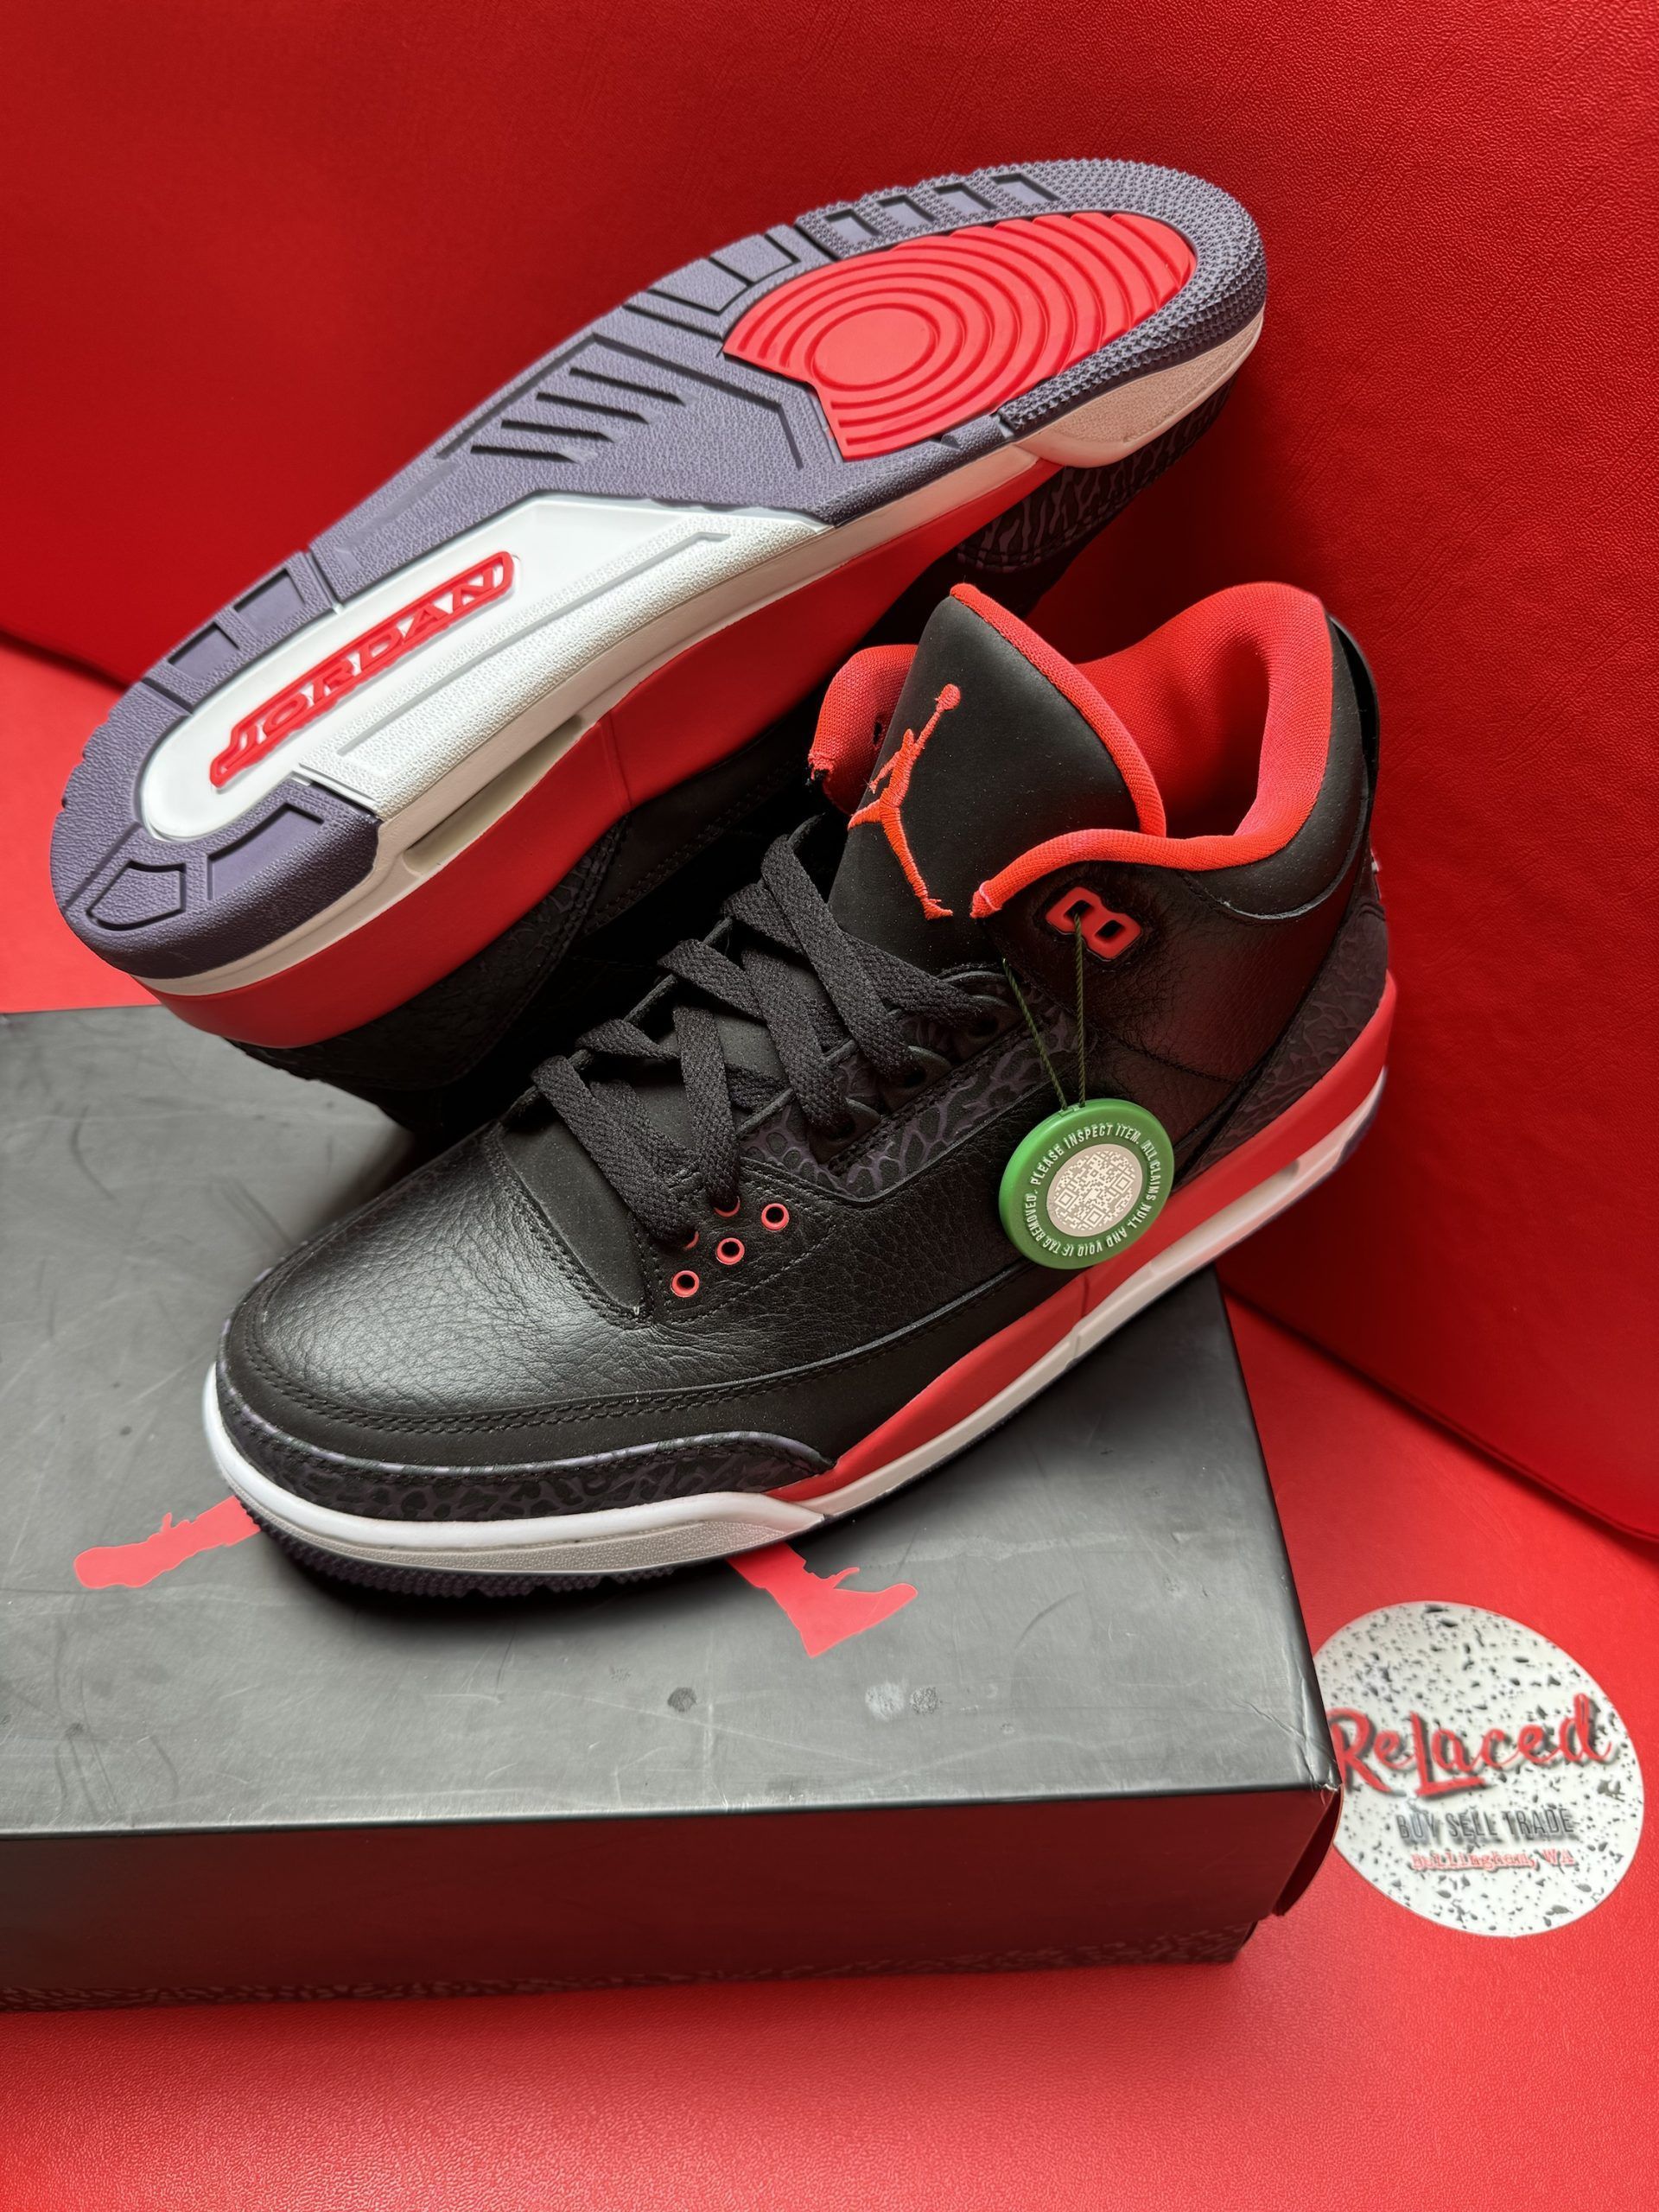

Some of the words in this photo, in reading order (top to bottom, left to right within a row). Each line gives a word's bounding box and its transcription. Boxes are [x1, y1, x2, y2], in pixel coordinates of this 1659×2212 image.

[212, 553, 512, 785] JORDAN
[1063, 1122, 1114, 1149] INSPECT
[1115, 1122, 1141, 1145] ITEM.
[1030, 1143, 1065, 1185] PLEASE
[1141, 1140, 1158, 1161] ALL
[1146, 1159, 1161, 1201] CLAIMS
[1024, 1190, 1048, 1242] REMOVED.
[1127, 1202, 1153, 1230] NULL
[1042, 1238, 1062, 1255] TAG
[1062, 1243, 1074, 1256] IF
[1077, 1243, 1103, 1257] VOID
[1106, 1226, 1128, 1248] AND
[1325, 1693, 1612, 1798] ReLaced
[1396, 1812, 1438, 1841] BUY
[1445, 1810, 1498, 1840] SELL
[1503, 1808, 1575, 1836] TRADE
